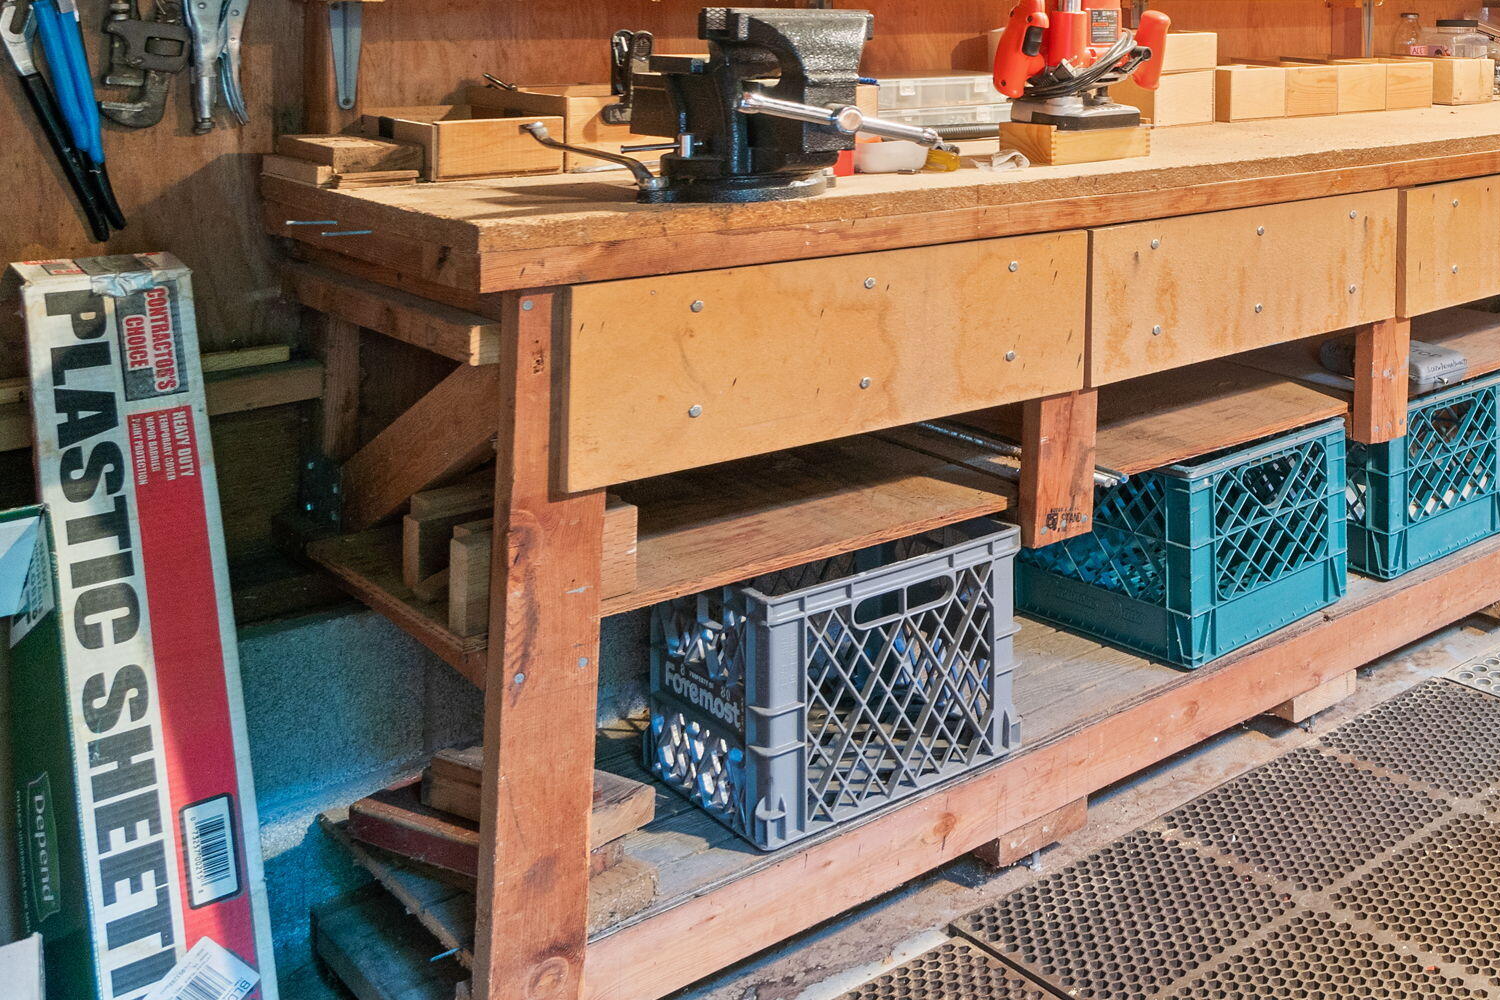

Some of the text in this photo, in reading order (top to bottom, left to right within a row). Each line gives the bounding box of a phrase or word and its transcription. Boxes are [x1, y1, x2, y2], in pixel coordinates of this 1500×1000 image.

[125, 315, 149, 369] CHOICE
[146, 286, 178, 391] CONTRACTOR'S
[44, 289, 143, 651] PLASTIC
[172, 411, 196, 478] HEAVY DUTY
[665, 660, 742, 730] Foremost
[34, 793, 55, 903] Depend
[82, 662, 179, 1000] SHEETI
